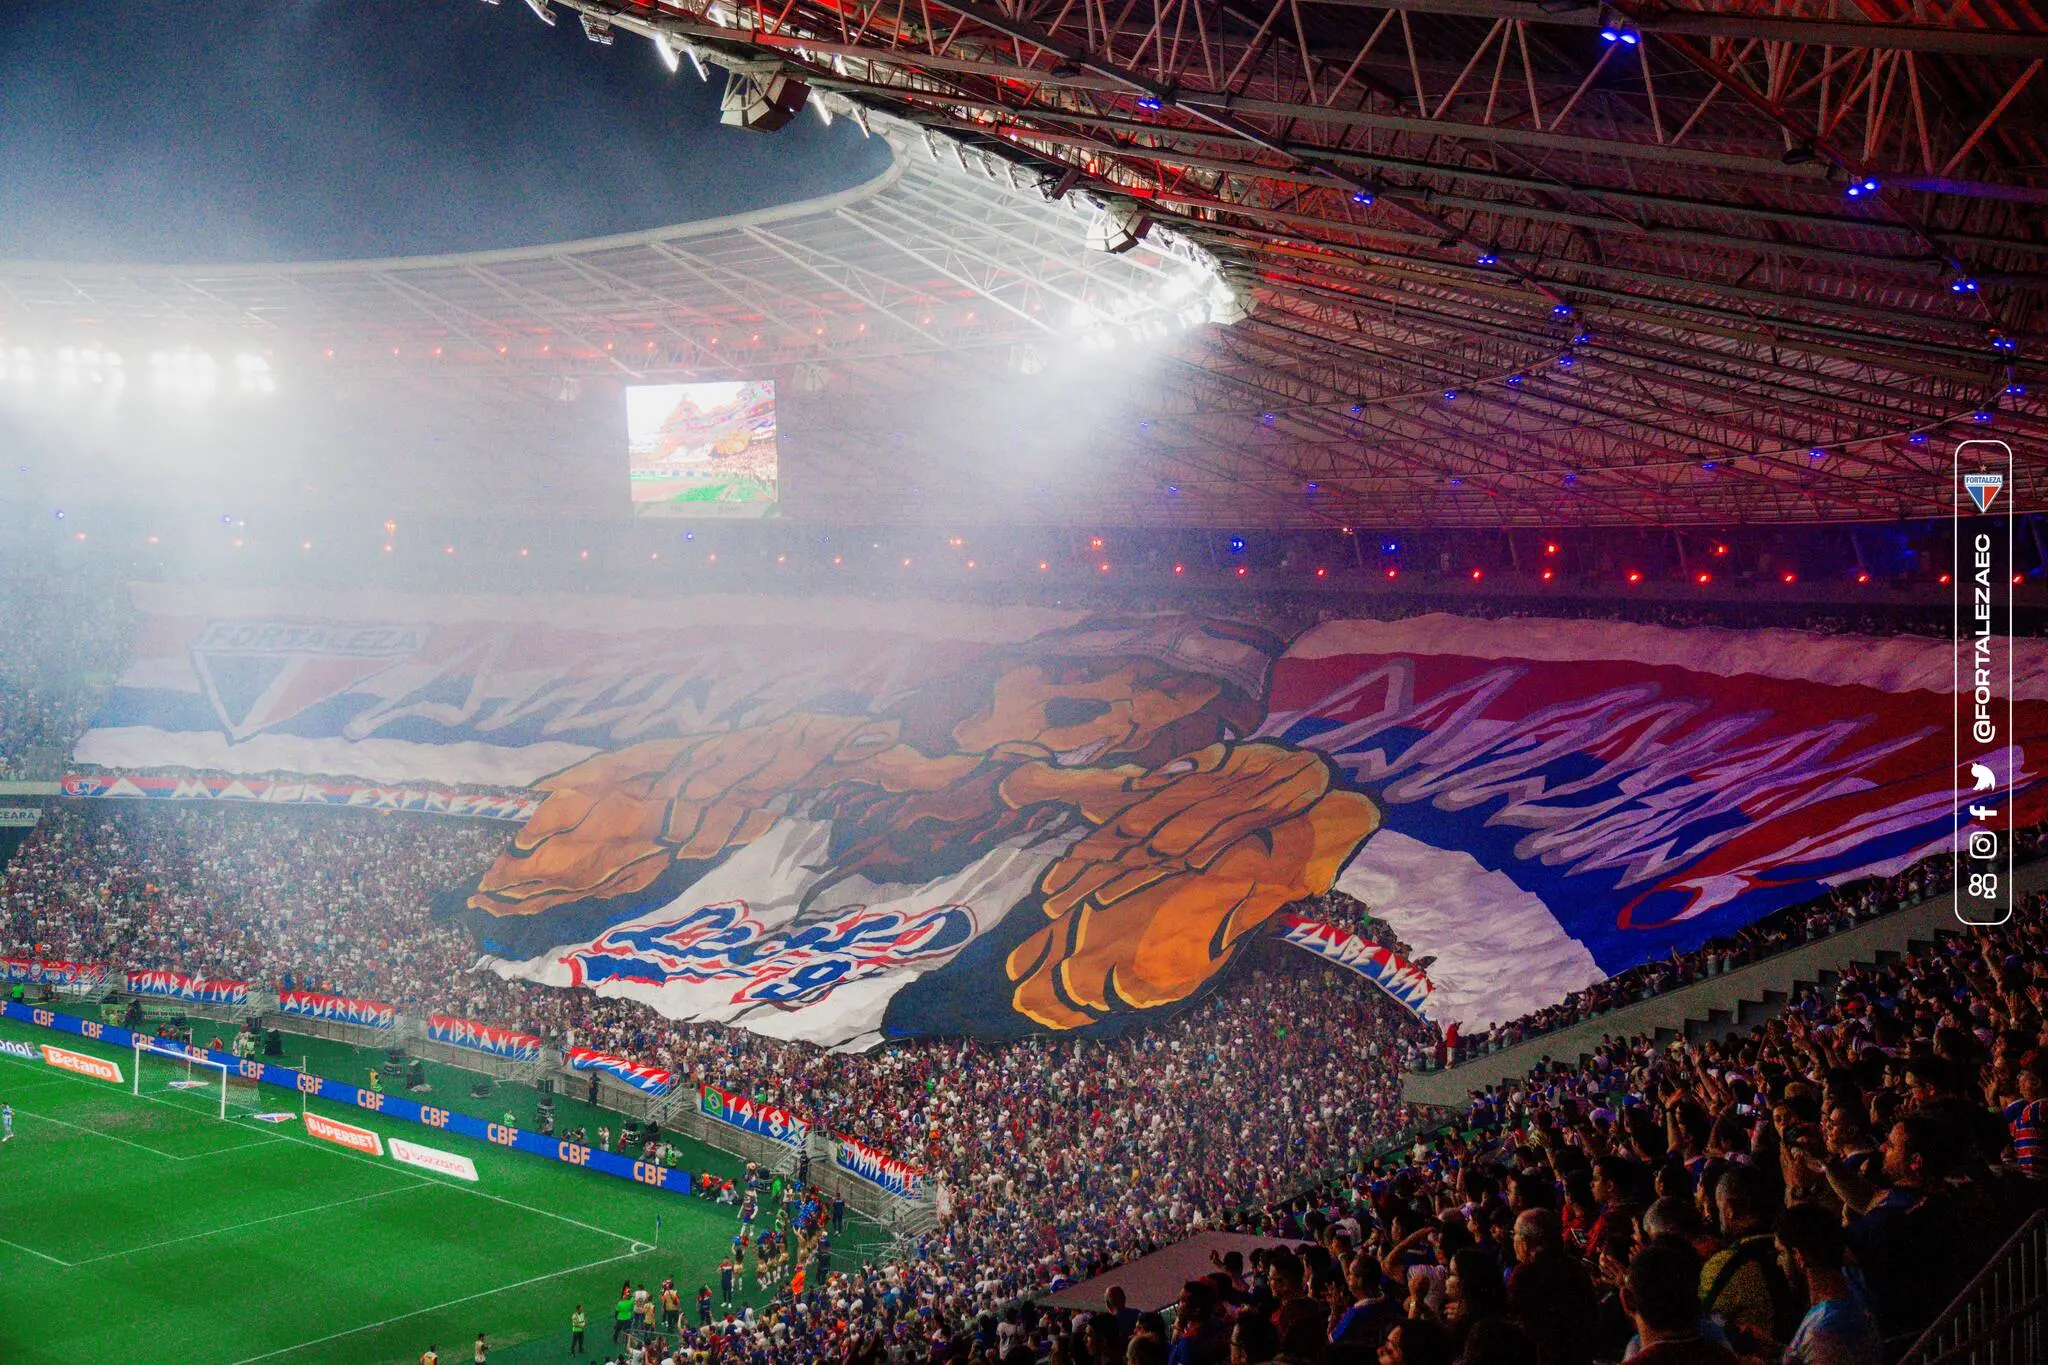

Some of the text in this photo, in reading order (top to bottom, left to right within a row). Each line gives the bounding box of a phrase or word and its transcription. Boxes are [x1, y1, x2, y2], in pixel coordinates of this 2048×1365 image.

[130, 970, 249, 1003] COMBATIVO
[33, 1009, 55, 1027] CBF
[284, 993, 391, 1026] AGUERRIDO
[81, 1020, 103, 1039] CBF
[132, 1032, 155, 1051] CBF
[433, 1019, 537, 1057] VIBRANTE
[48, 1049, 113, 1078] Betano
[240, 1059, 264, 1079] CBF
[297, 1073, 322, 1095] CBF
[357, 1089, 384, 1111] CBF
[420, 1106, 449, 1128] CBF
[727, 1096, 785, 1137] 1918
[307, 1117, 373, 1148] SUPERBET
[487, 1123, 518, 1147] CBF
[558, 1142, 591, 1166] CBF
[633, 1161, 668, 1187] CBF
